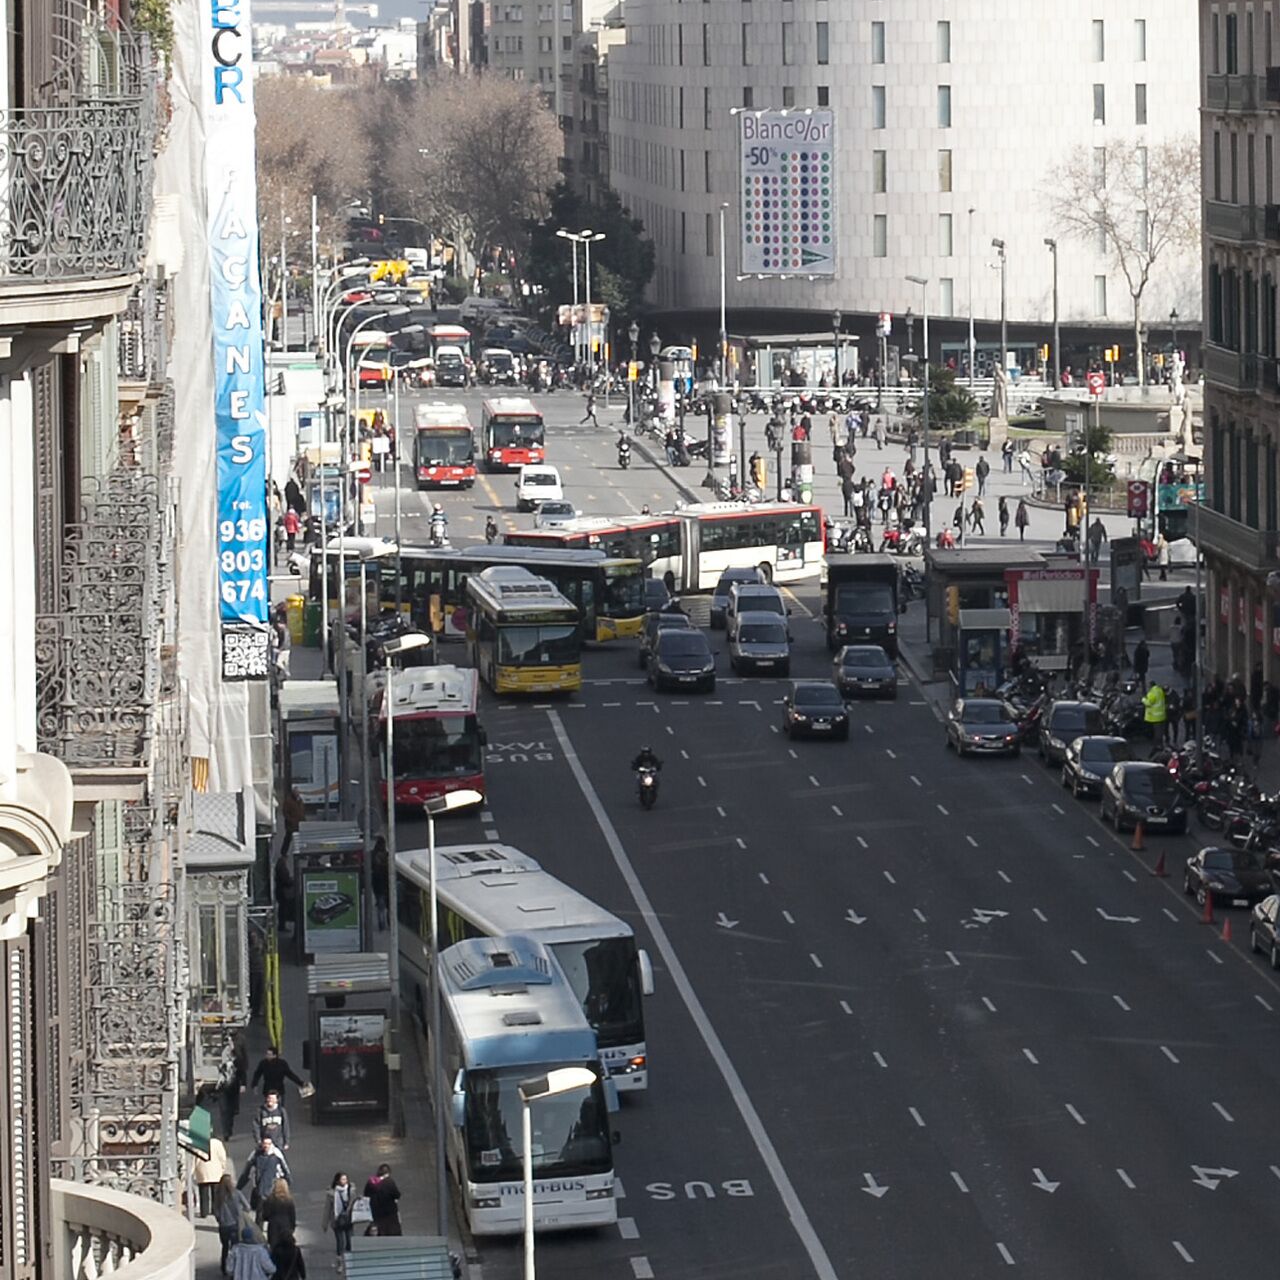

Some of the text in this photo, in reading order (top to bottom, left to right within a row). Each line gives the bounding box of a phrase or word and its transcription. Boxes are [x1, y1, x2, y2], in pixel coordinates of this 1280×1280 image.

[220, 520, 264, 543] 936
[221, 549, 264, 573] 803
[222, 581, 265, 603] 674
[487, 742, 552, 751] TAXI
[485, 753, 553, 763] BUS
[645, 1179, 755, 1200] BUS
